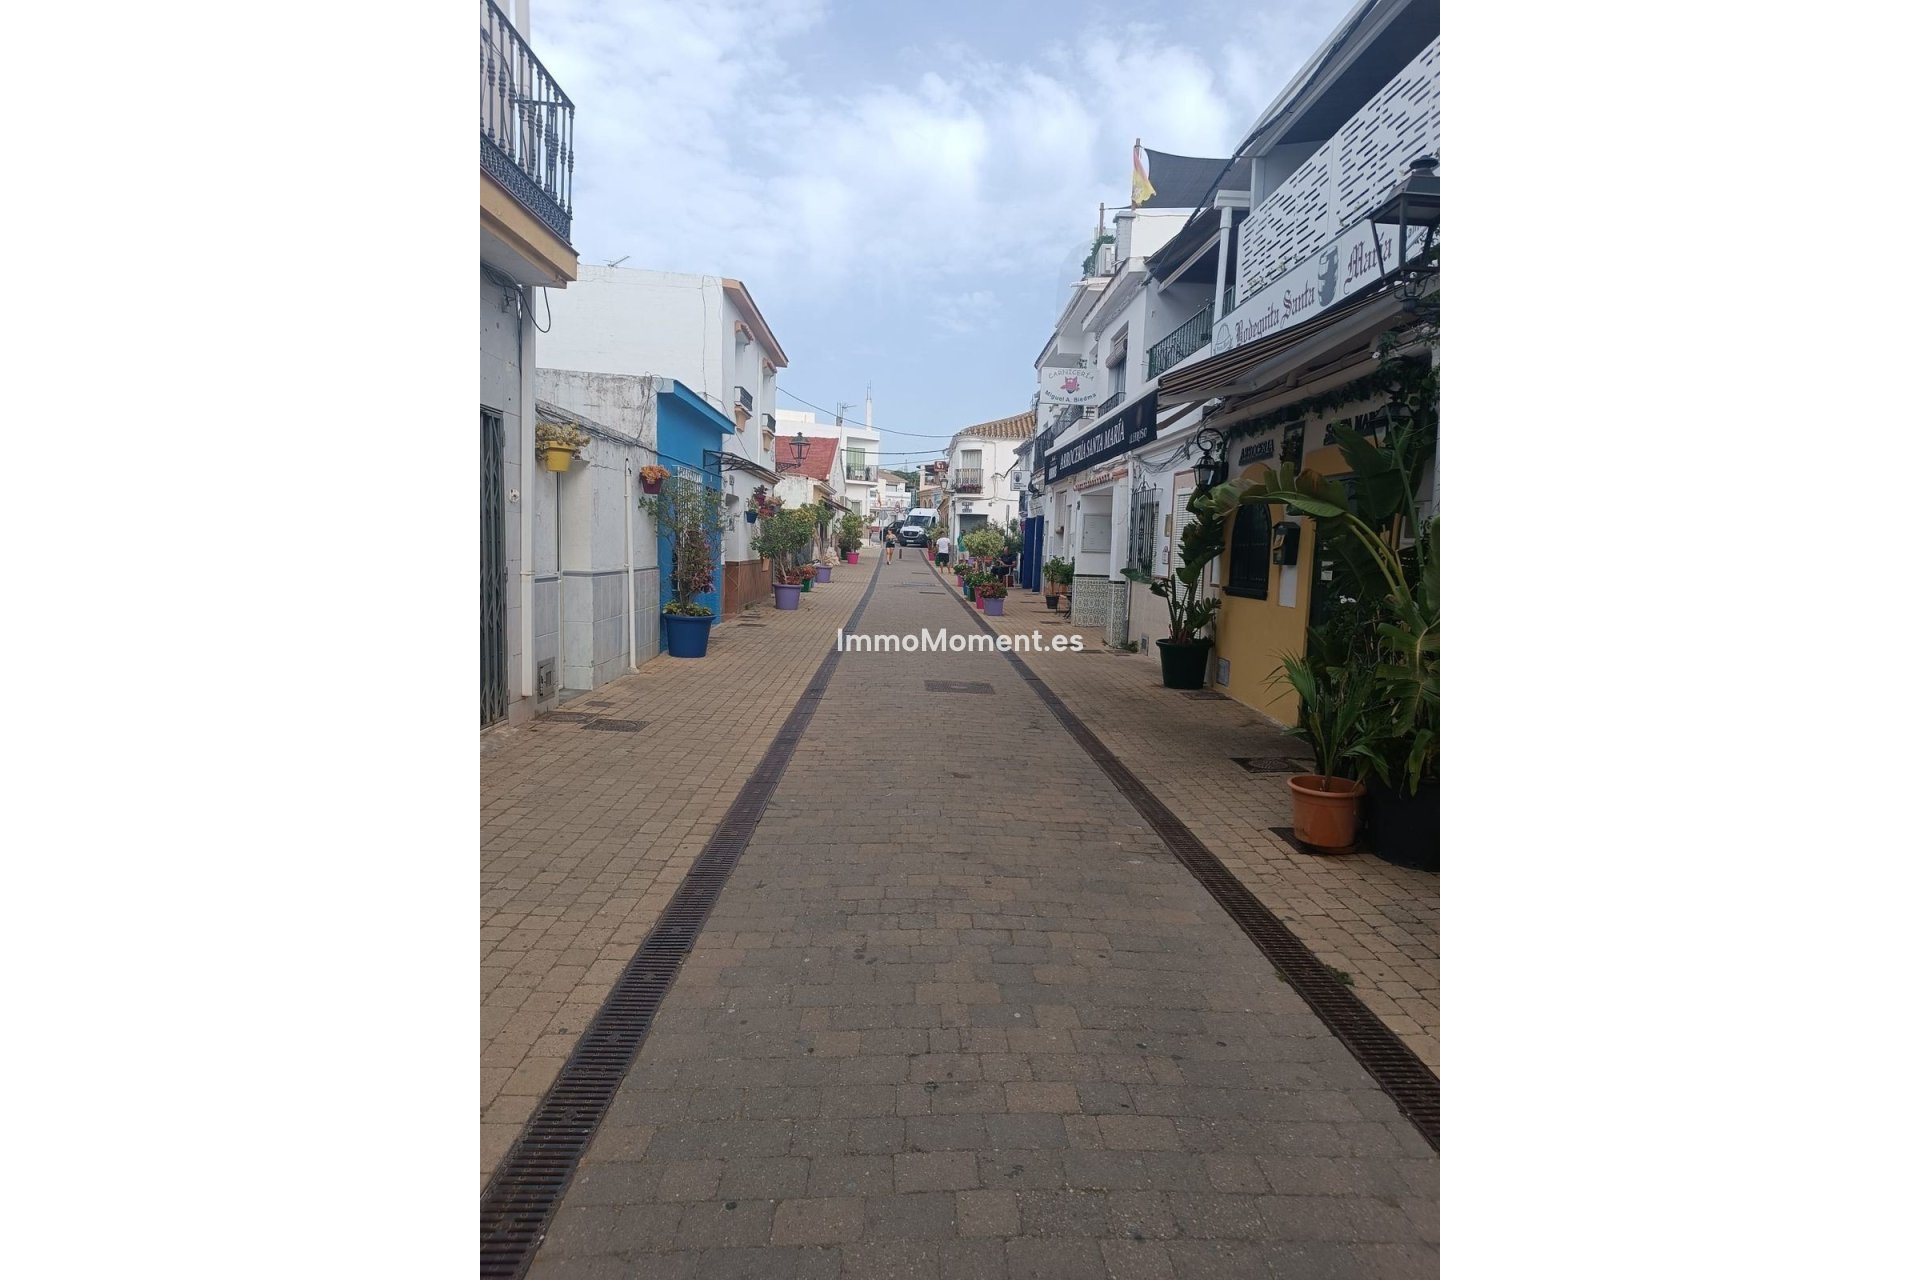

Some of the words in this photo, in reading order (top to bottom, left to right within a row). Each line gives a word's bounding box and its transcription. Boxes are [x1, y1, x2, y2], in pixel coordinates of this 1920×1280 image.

[1280, 280, 1315, 329] Santa
[1045, 390, 1064, 402] Miguel
[1086, 432, 1103, 459] SANTA
